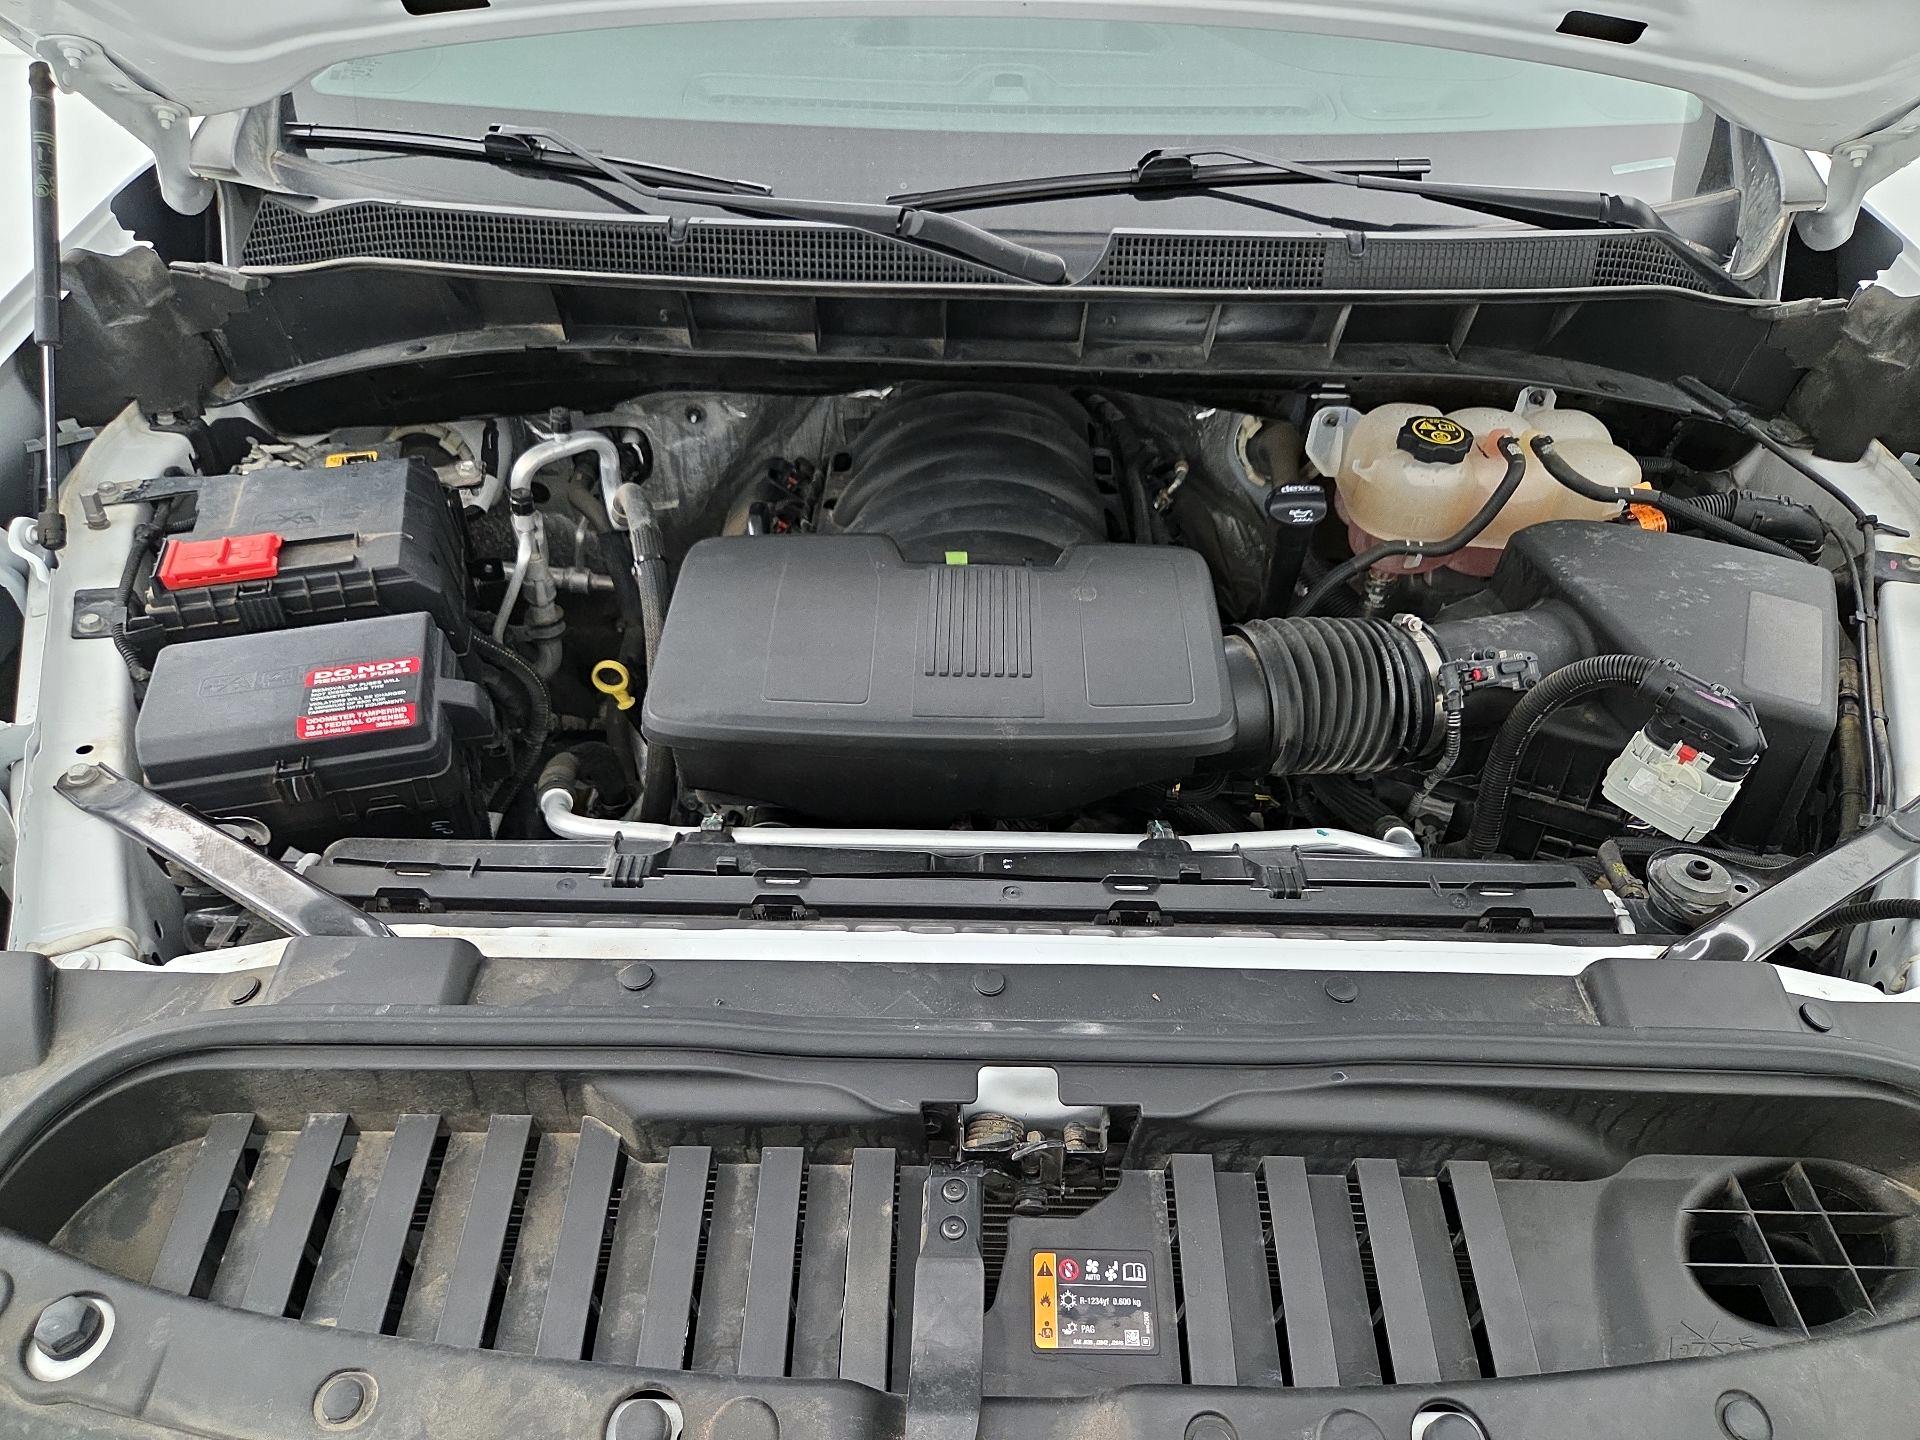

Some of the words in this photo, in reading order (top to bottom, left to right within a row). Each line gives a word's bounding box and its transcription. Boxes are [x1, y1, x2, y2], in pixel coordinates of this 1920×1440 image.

[1281, 484, 1320, 493] dexos
[314, 668, 353, 680] DO
[358, 659, 411, 674] NOT
[314, 673, 367, 685] REMOVE
[370, 667, 411, 677] FUSES
[312, 685, 346, 694] REMOVAL
[347, 682, 359, 690] OF
[360, 680, 383, 688] FUSES
[347, 695, 363, 703] WILL
[374, 690, 407, 698] CHARGED
[346, 702, 365, 710] WITH
[306, 713, 356, 725] ODOMETER
[358, 706, 408, 718] TAMPERING
[325, 718, 365, 729] FEDERAL
[366, 714, 408, 724] OFFENSE.
[1085, 1273, 1101, 1281] AUTO
[1080, 1297, 1110, 1307] R-1234yf
[1112, 1298, 1131, 1306] 0.600
[1132, 1299, 1142, 1308] kg
[1081, 1325, 1096, 1334] PAG
